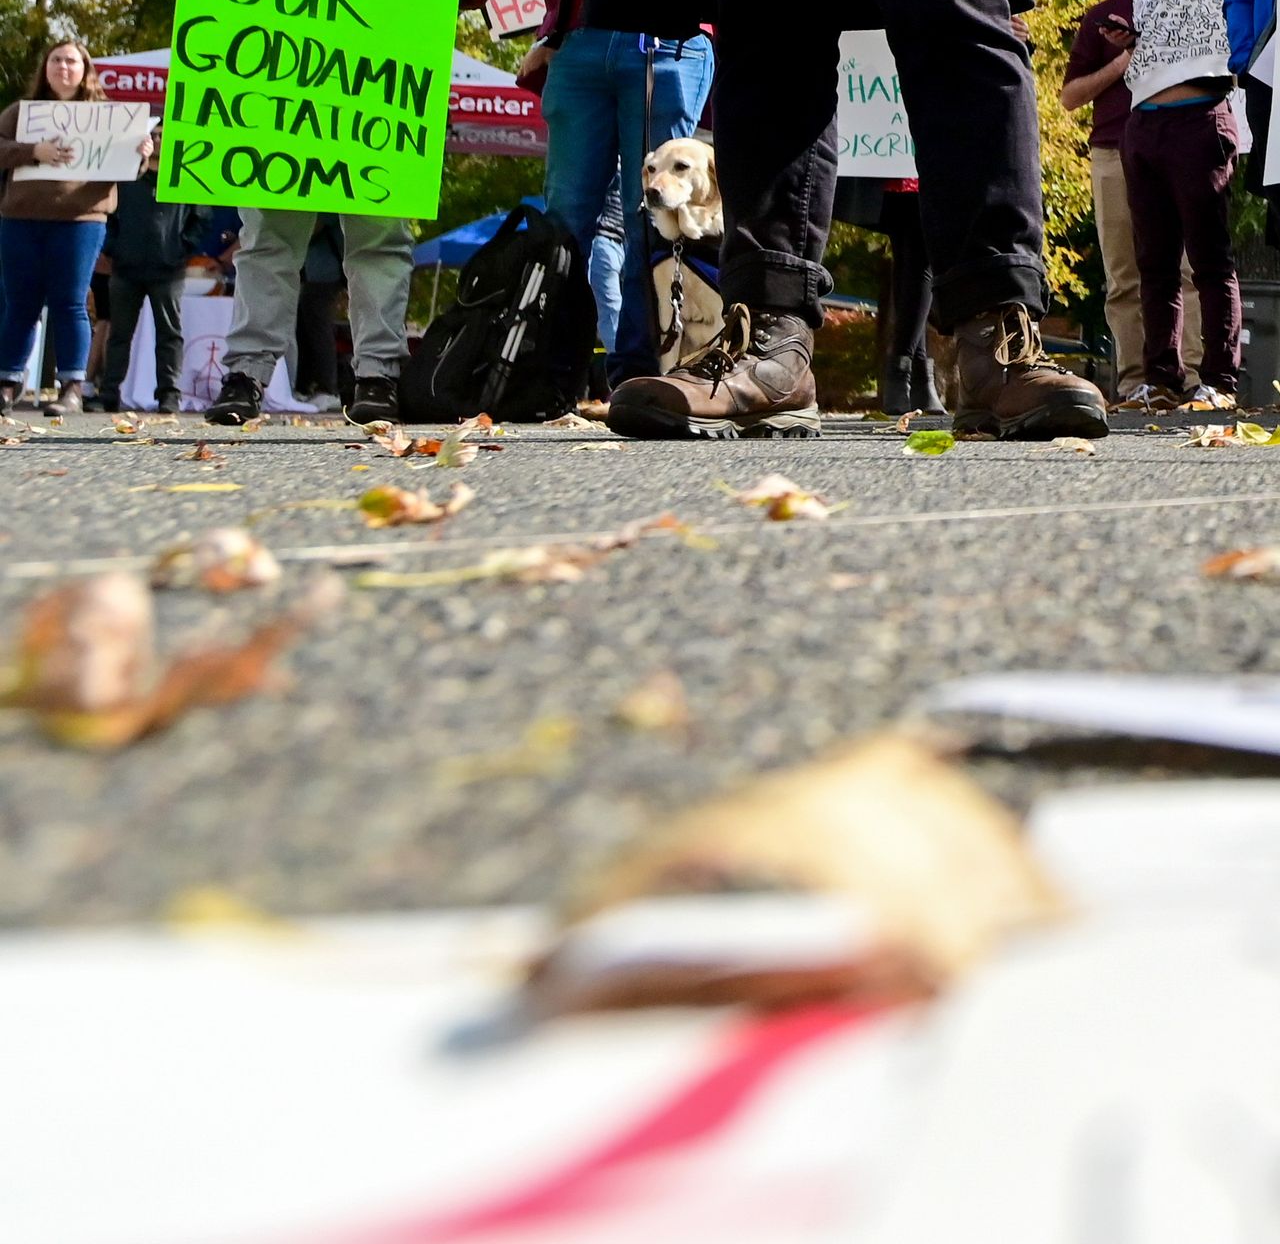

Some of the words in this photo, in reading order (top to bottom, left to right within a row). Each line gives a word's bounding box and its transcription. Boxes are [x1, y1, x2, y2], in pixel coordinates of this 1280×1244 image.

[101, 69, 168, 92] Cath
[449, 92, 534, 116] Center
[176, 15, 434, 118] GODDAMN
[26, 102, 144, 136] EQUITY
[171, 81, 428, 157] LACTATION
[168, 140, 391, 204] ROOMS
